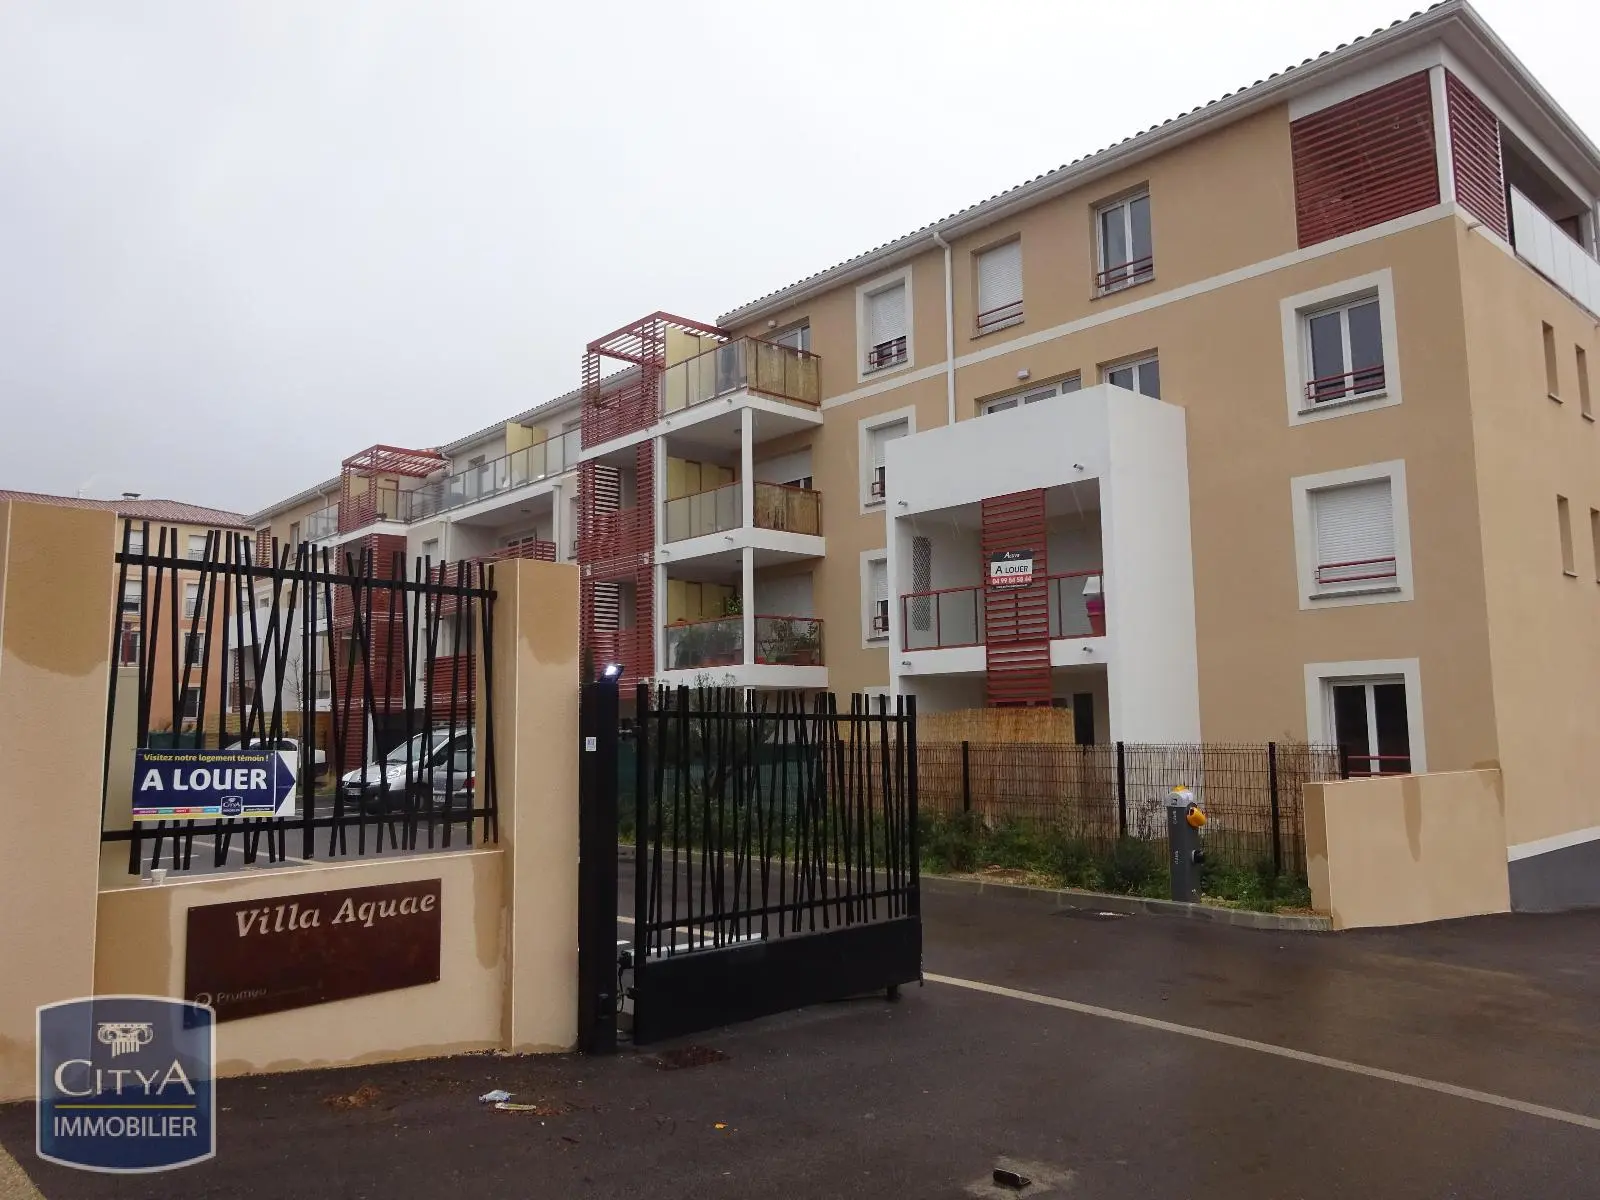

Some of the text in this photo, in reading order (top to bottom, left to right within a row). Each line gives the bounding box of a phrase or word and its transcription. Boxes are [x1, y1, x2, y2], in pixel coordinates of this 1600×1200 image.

[995, 566, 1028, 574] A LOUER
[198, 754, 236, 762] logement
[140, 768, 268, 790] A LOUER
[235, 894, 436, 938] Villa Aquae
